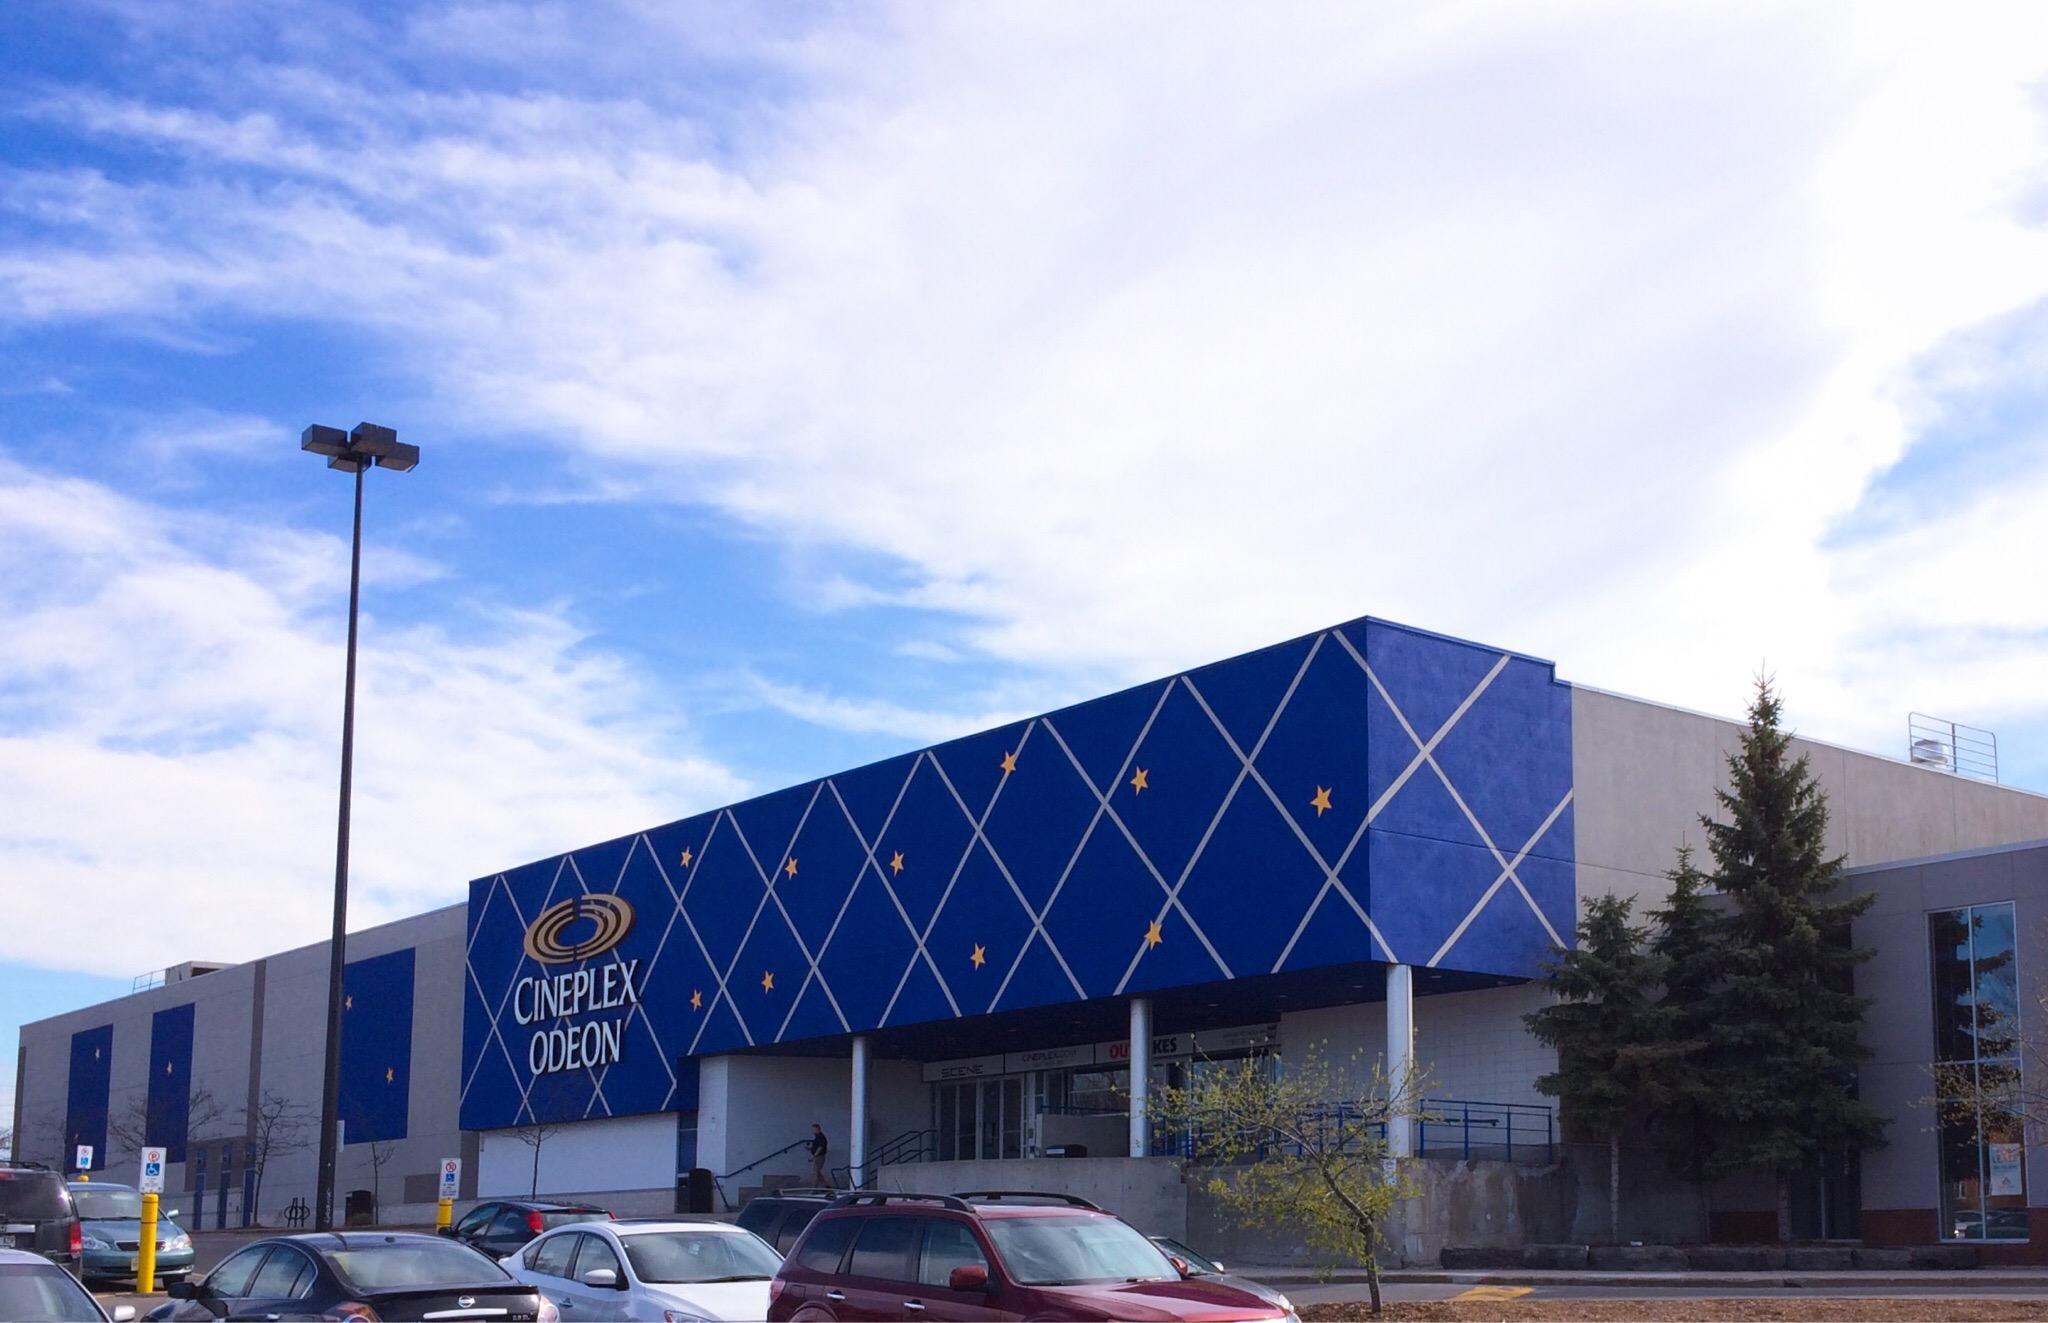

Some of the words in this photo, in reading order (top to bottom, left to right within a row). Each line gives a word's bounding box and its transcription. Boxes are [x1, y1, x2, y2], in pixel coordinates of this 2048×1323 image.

[513, 959, 639, 1025] CINEPLEX
[529, 1019, 622, 1075] ODEON
[1109, 1037, 1177, 1059] OUKES
[941, 1064, 984, 1078] SCENE
